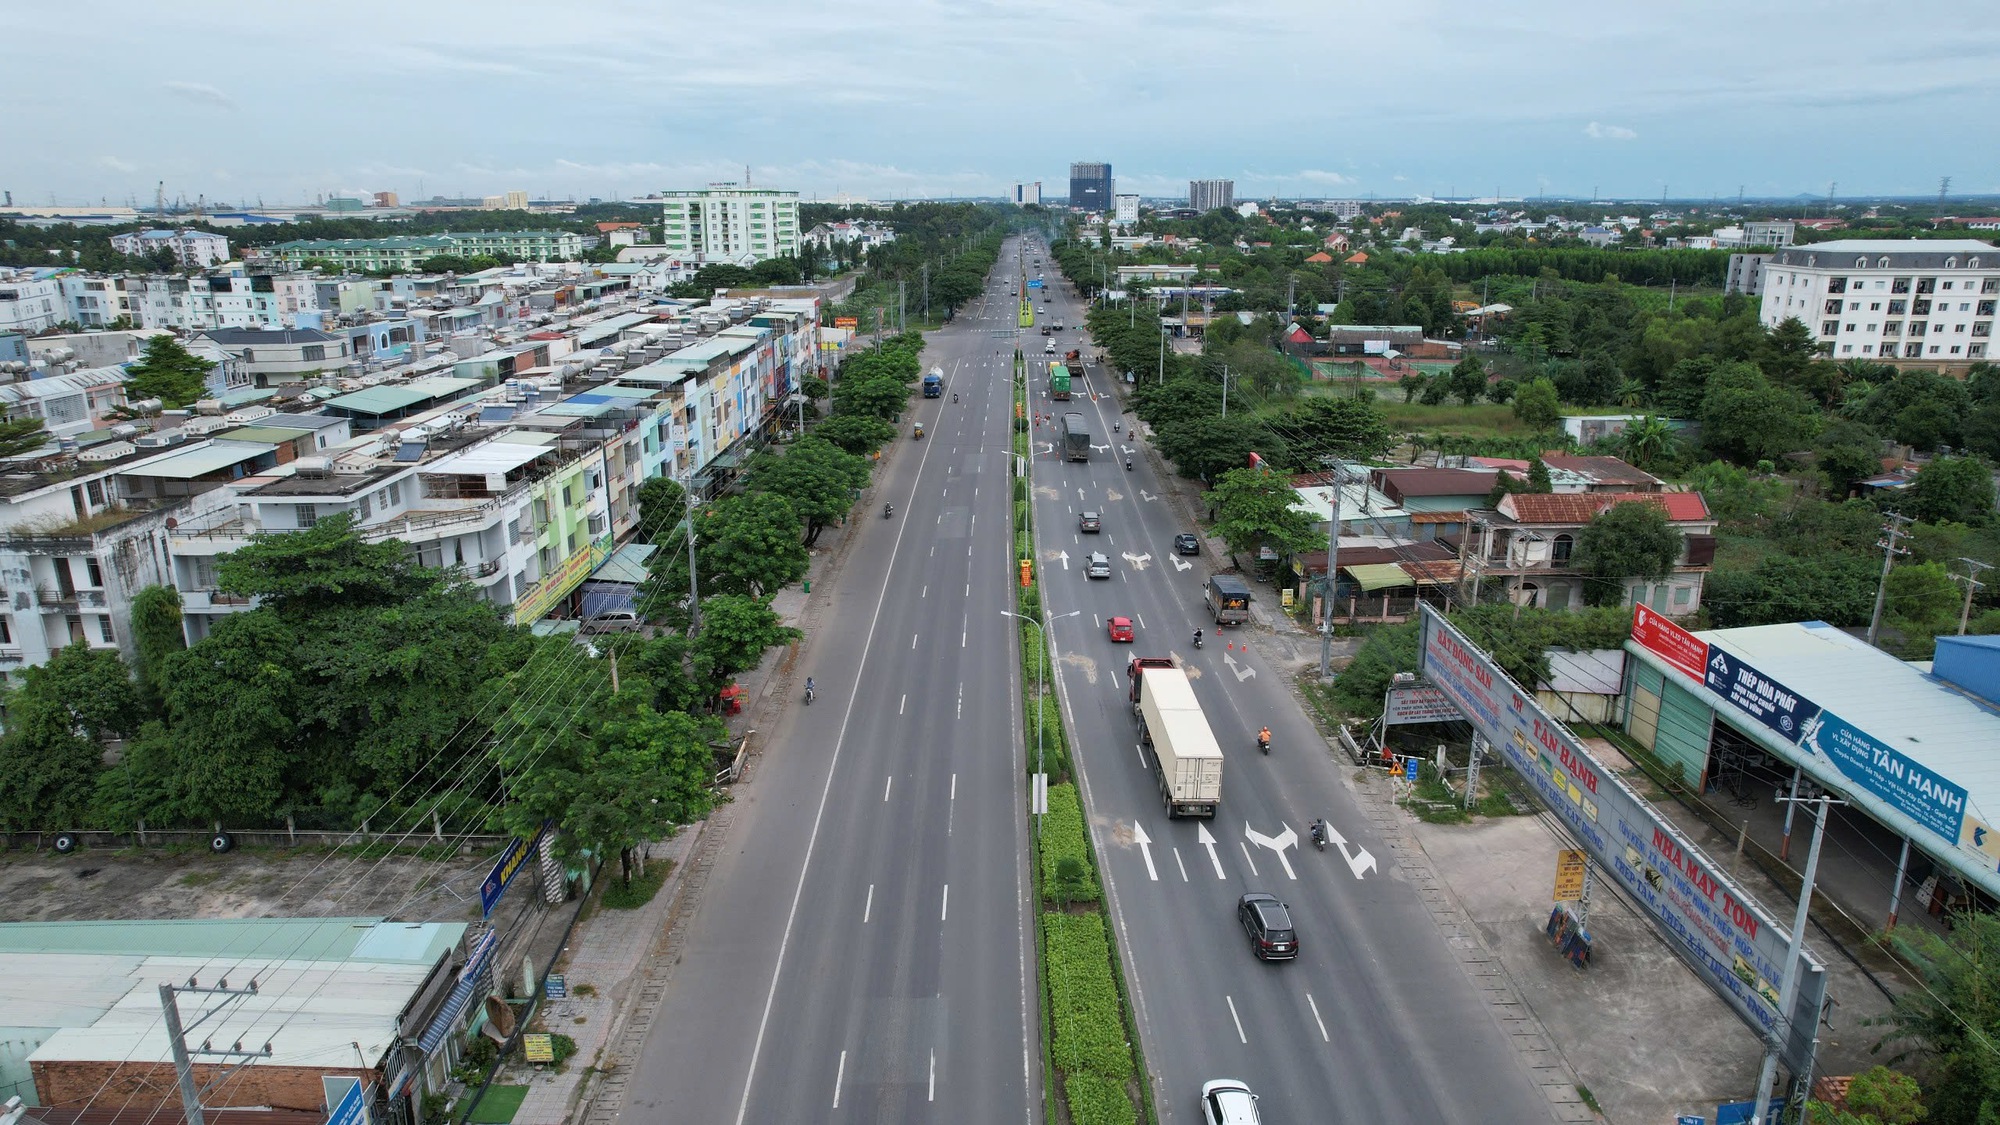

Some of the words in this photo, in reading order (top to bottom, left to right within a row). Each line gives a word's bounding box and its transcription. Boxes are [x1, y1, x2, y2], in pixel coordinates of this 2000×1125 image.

[1738, 668, 1757, 688] THÉP
[1756, 680, 1774, 700] HÒA
[1773, 690, 1797, 713] PHÁT
[1533, 718, 1559, 754] TÂN
[1560, 744, 1598, 794] HẠNH
[1832, 733, 1839, 741] VL
[1840, 737, 1851, 748] XÂY
[1852, 744, 1869, 759] DỰNG
[1841, 729, 1852, 740] CỬA
[1853, 736, 1870, 750] HÀNG
[1872, 747, 1904, 779] TÂN
[1907, 769, 1962, 813] HẠNH
